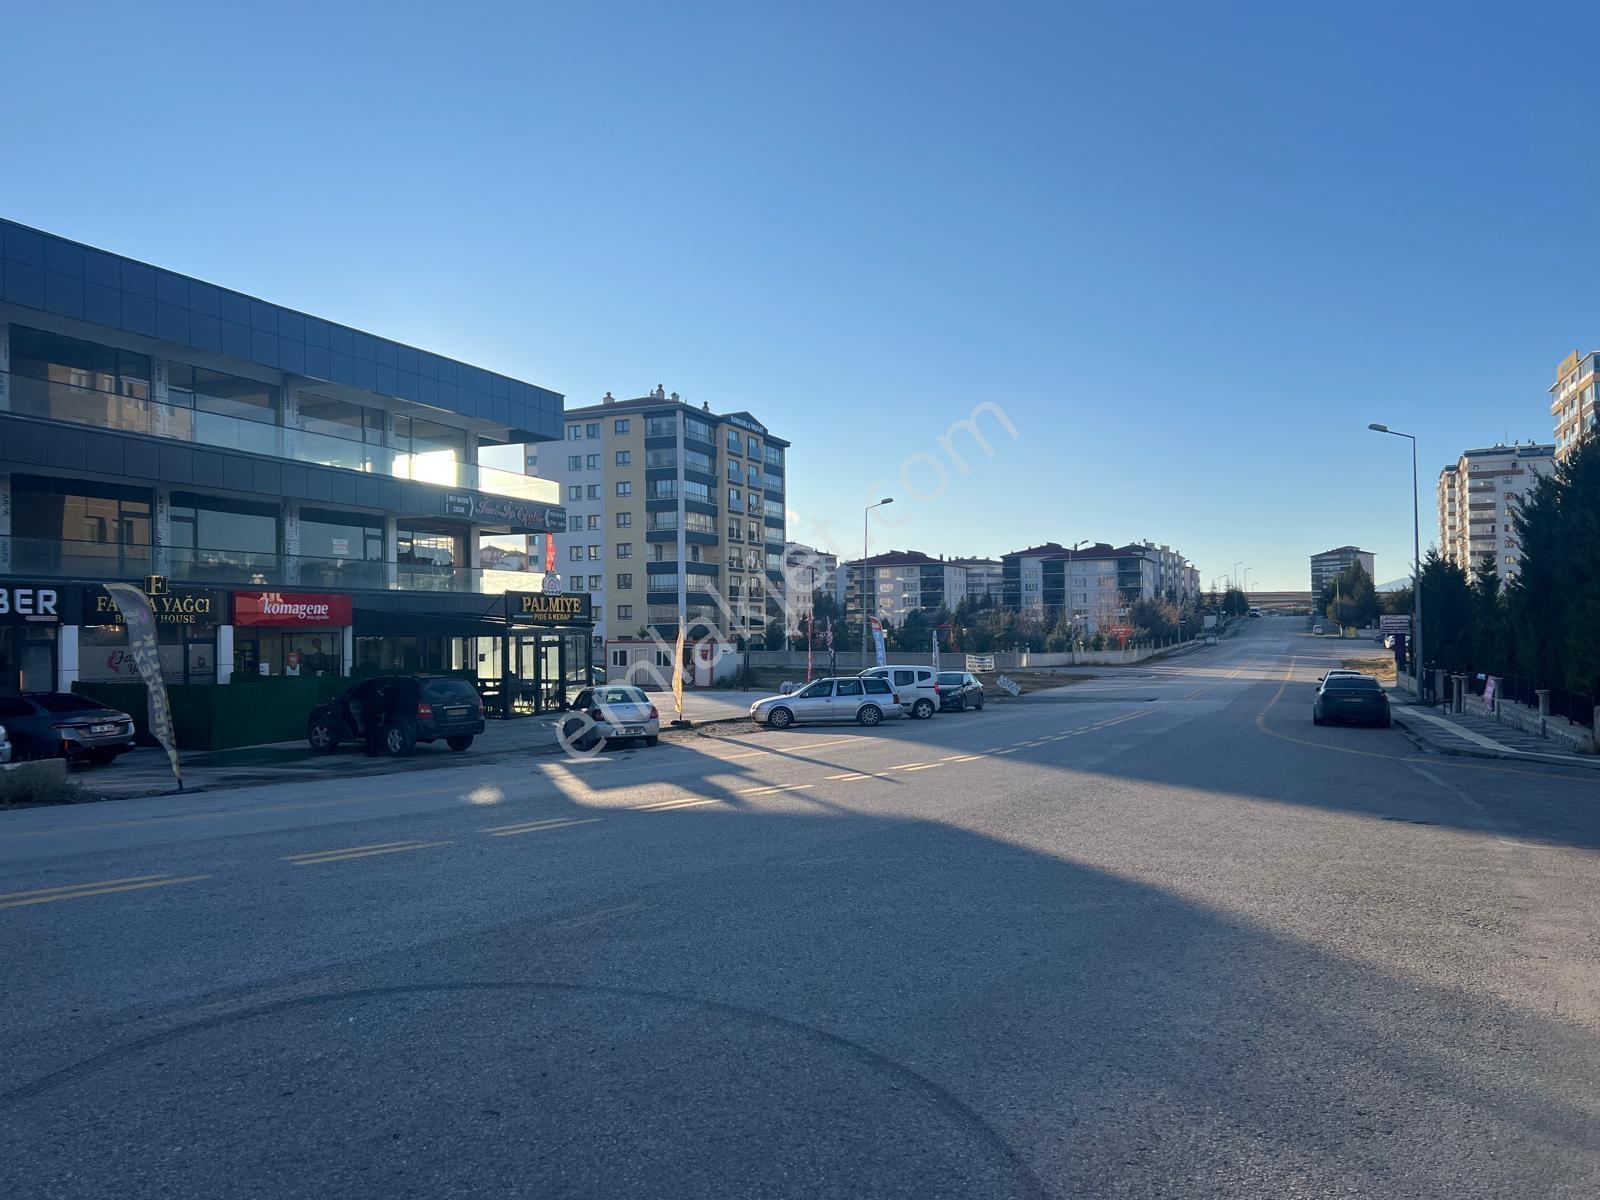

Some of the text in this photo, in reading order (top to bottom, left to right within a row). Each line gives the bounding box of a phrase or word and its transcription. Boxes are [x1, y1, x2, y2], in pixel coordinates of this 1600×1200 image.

[161, 593, 211, 613] YAĞCI
[263, 597, 329, 620] komagene
[521, 595, 582, 613] PALMİYE
[160, 614, 196, 624] HOUSE
